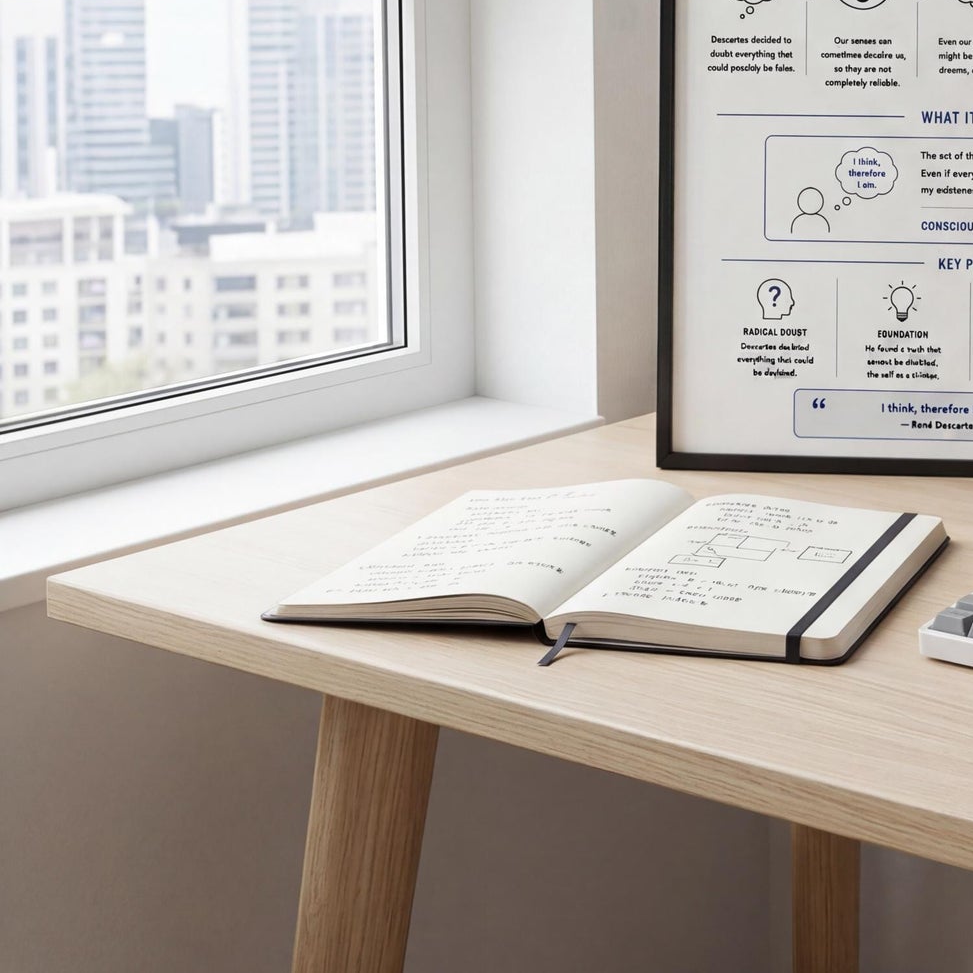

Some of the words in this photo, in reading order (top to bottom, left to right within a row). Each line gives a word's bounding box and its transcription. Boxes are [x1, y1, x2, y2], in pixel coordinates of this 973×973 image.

[938, 52, 961, 61] might
[878, 66, 892, 74] not
[921, 111, 960, 124] WHAT
[954, 152, 964, 160] of
[848, 169, 886, 177] therefore
[921, 169, 942, 177] Even
[944, 169, 951, 177] if
[938, 258, 961, 269] KEY
[743, 328, 778, 336] RADICAL
[887, 403, 917, 415] think,
[920, 404, 969, 414] therefore
